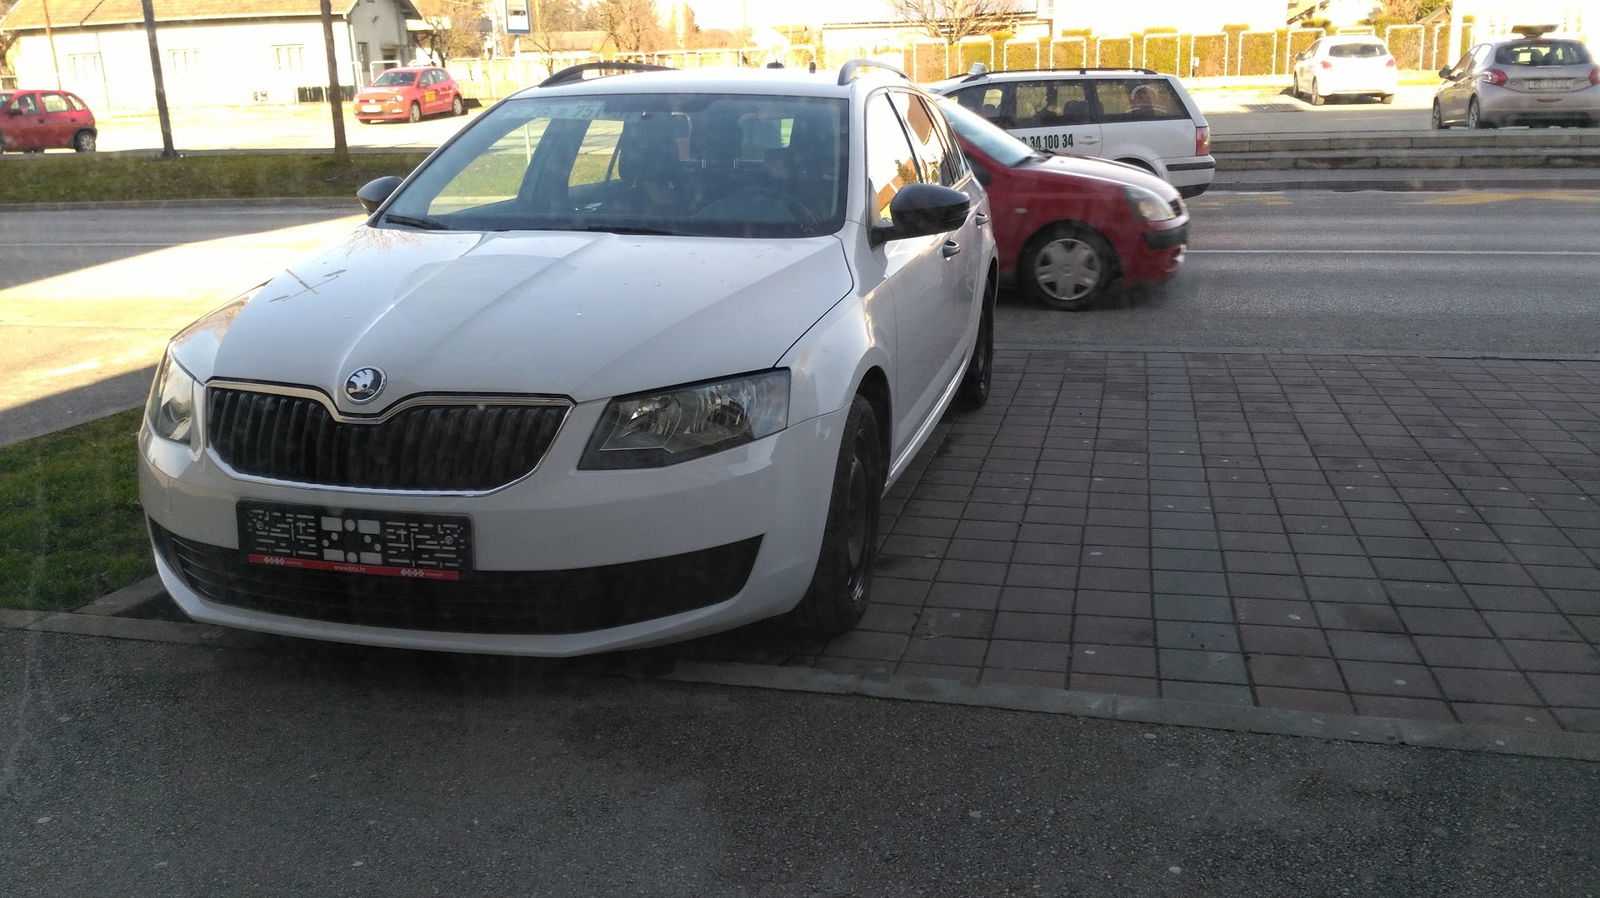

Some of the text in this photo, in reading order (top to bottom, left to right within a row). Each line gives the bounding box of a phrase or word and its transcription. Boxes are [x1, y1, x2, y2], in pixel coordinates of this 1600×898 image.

[1029, 135, 1042, 149] 34
[1043, 134, 1060, 149] 100
[1061, 133, 1074, 148] 34
